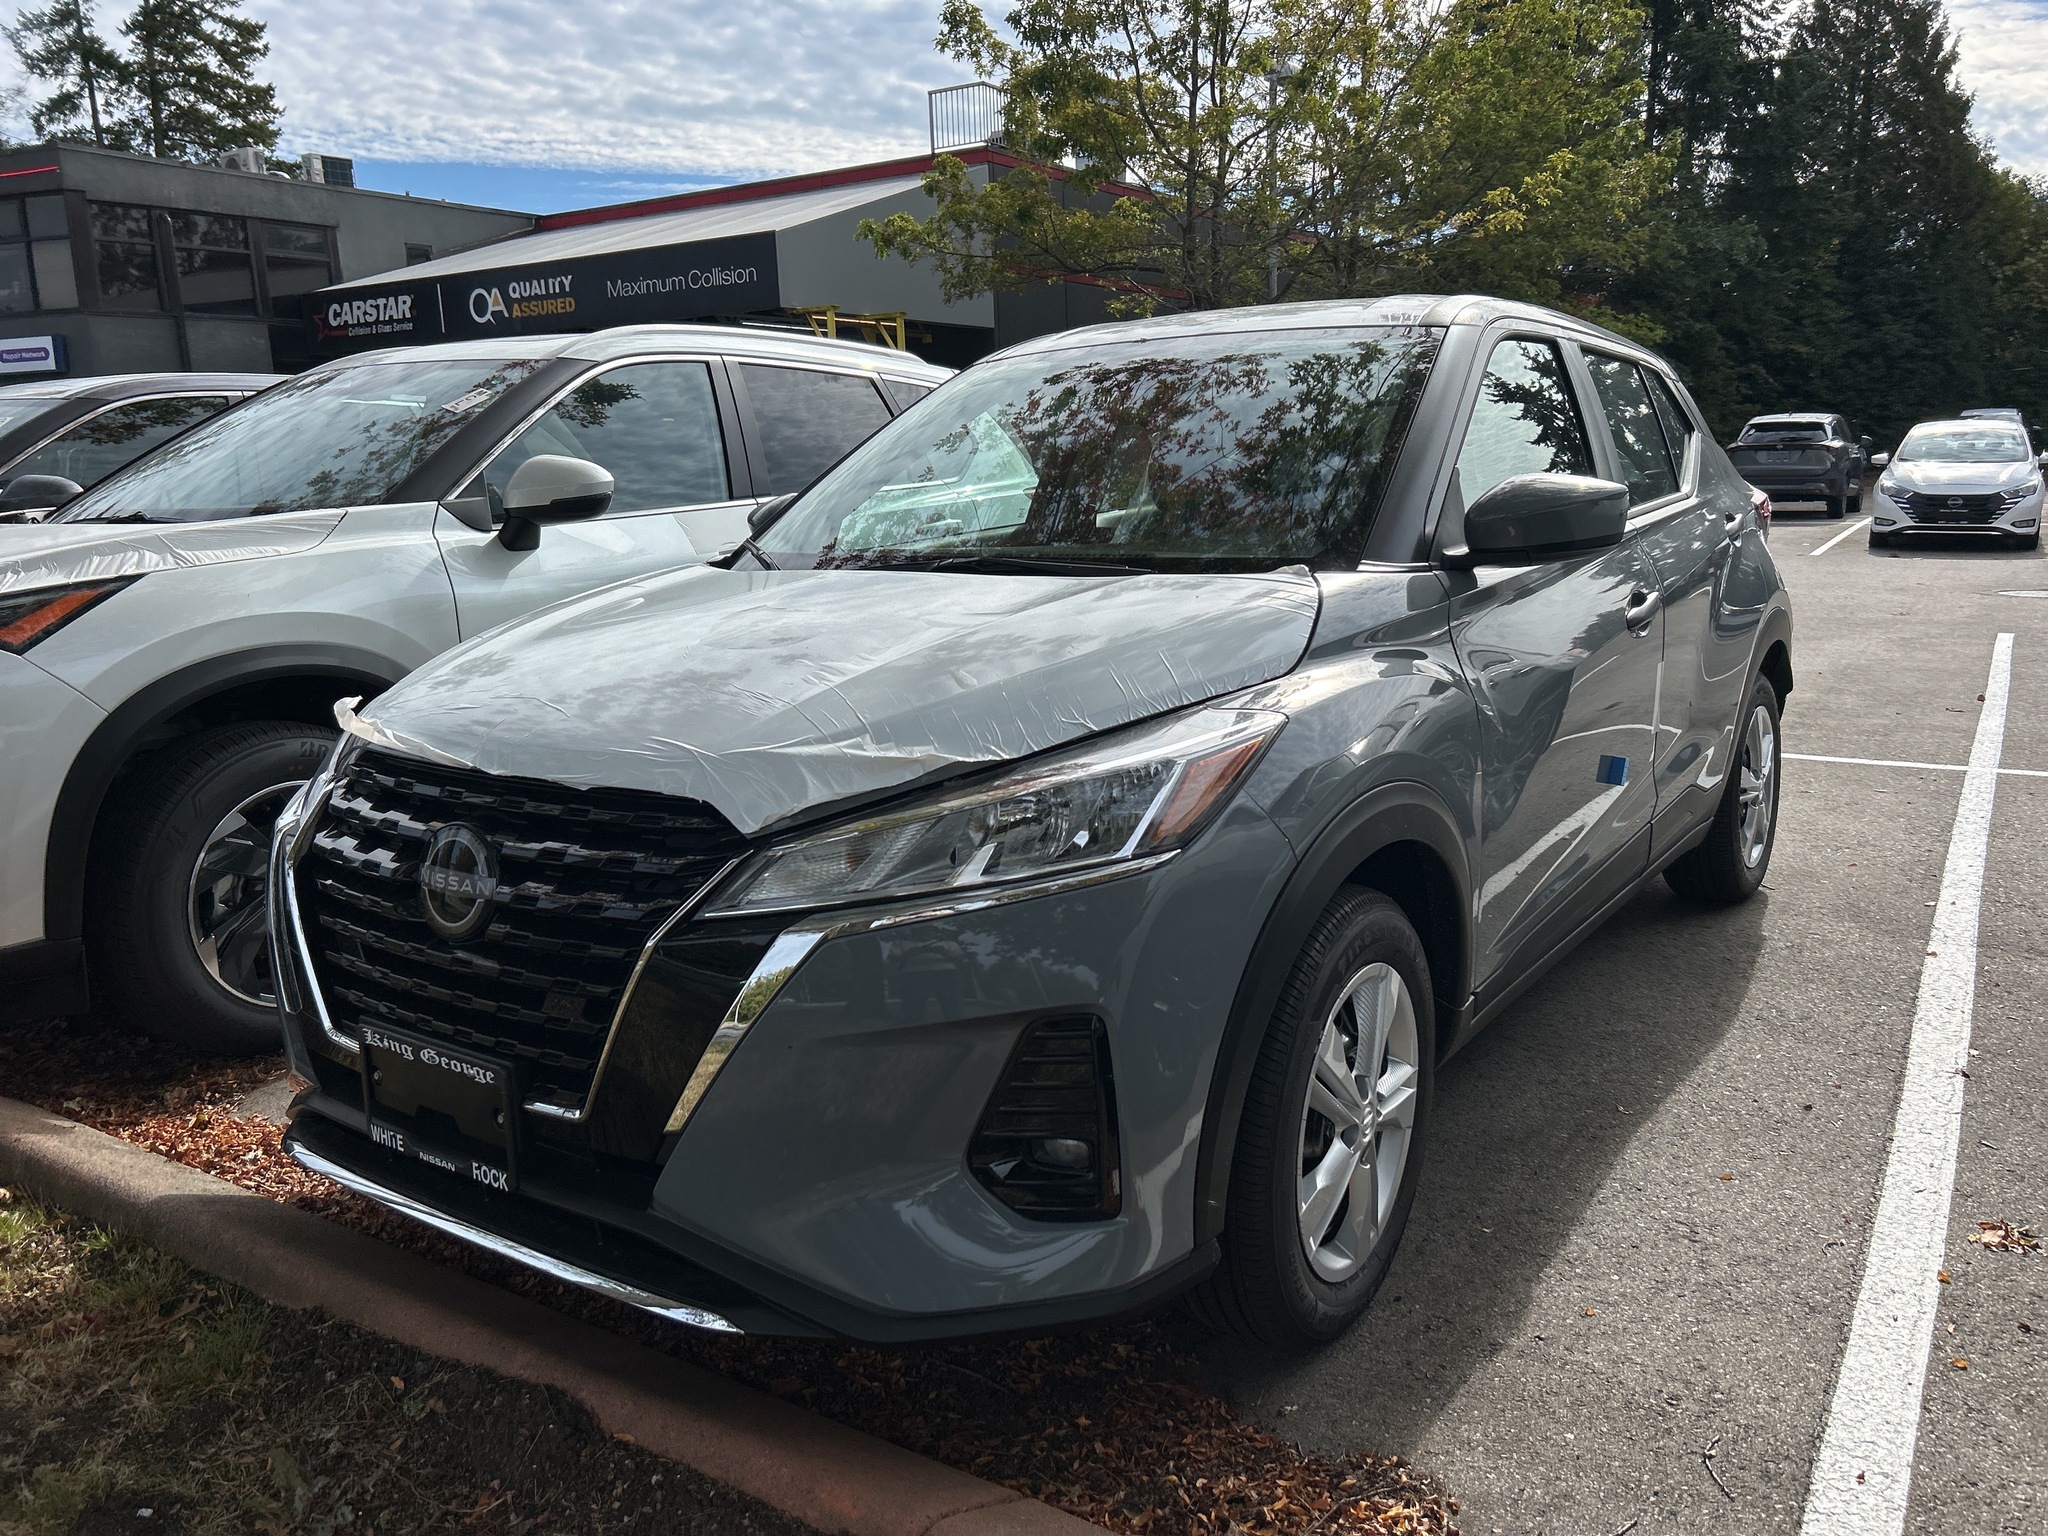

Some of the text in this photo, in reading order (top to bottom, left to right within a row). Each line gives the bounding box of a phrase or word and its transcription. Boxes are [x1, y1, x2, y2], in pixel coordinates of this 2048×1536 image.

[606, 265, 757, 298] Maximum Collision
[328, 295, 412, 327] CARSTAR
[512, 297, 576, 318] ASSURED
[348, 320, 414, 337] Collision & Glass Service
[421, 867, 491, 896] NISSAN
[362, 1028, 496, 1084] King George
[370, 1124, 509, 1192] WHITE NISSAN ROCK
